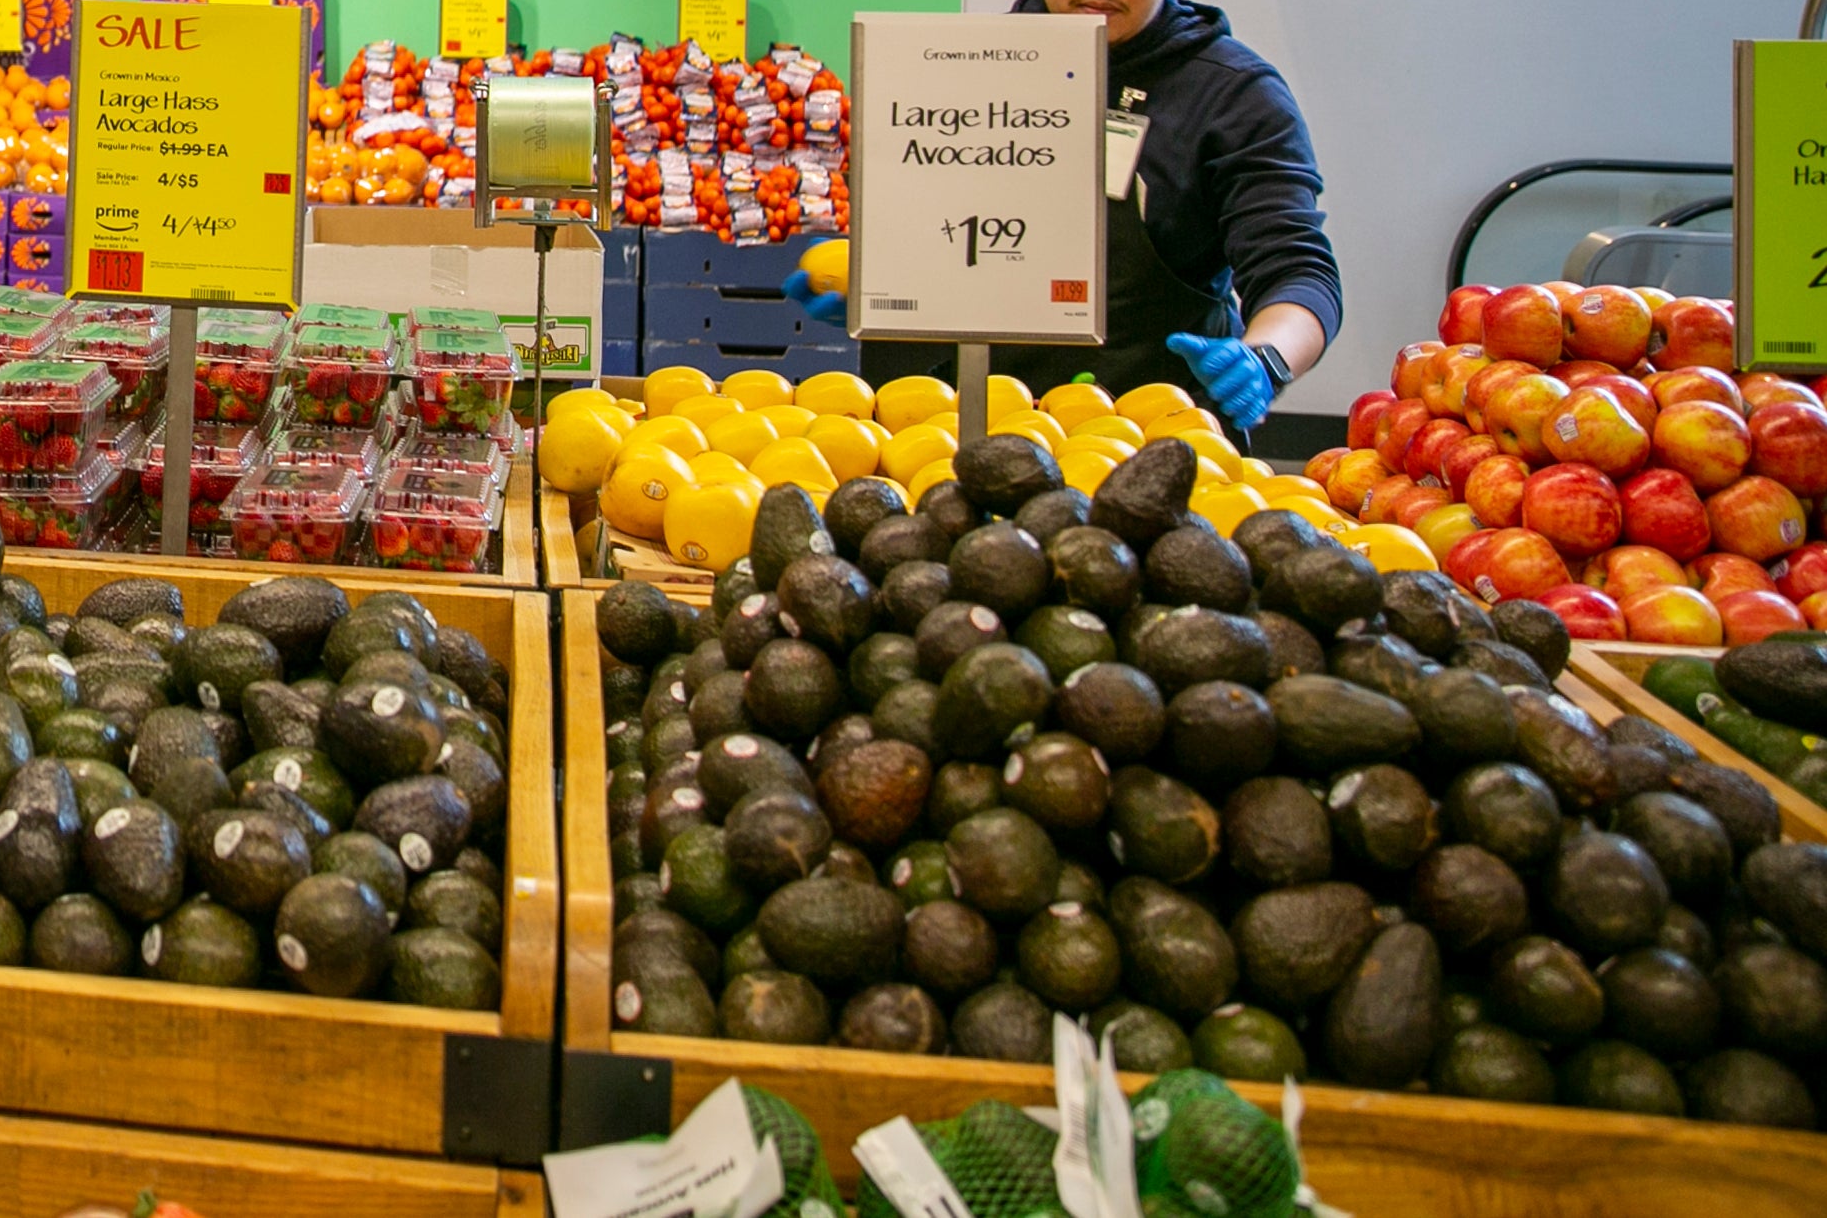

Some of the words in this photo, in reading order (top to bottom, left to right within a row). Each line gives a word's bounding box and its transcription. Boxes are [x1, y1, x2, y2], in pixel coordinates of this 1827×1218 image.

[95, 14, 201, 51] SALE
[923, 47, 966, 61] Grown
[968, 50, 980, 61] in
[982, 49, 1039, 62] MEXICO
[100, 69, 133, 81] Grown
[134, 71, 143, 81] in
[145, 71, 180, 83] Mexico
[99, 89, 159, 114] Large
[163, 91, 219, 111] Hass
[96, 113, 198, 135] Avocados
[891, 101, 981, 135] Large
[988, 101, 1071, 128] Hass
[97, 141, 128, 152] Regular
[130, 143, 154, 152] Price:
[159, 140, 203, 157] $1.99
[207, 143, 229, 157] EA
[902, 139, 1056, 166] Avocados
[96, 171, 114, 181] Sale
[115, 173, 139, 182] Price:
[157, 173, 199, 189] 4/$5
[95, 204, 140, 219] prime
[94, 234, 120, 242] Member
